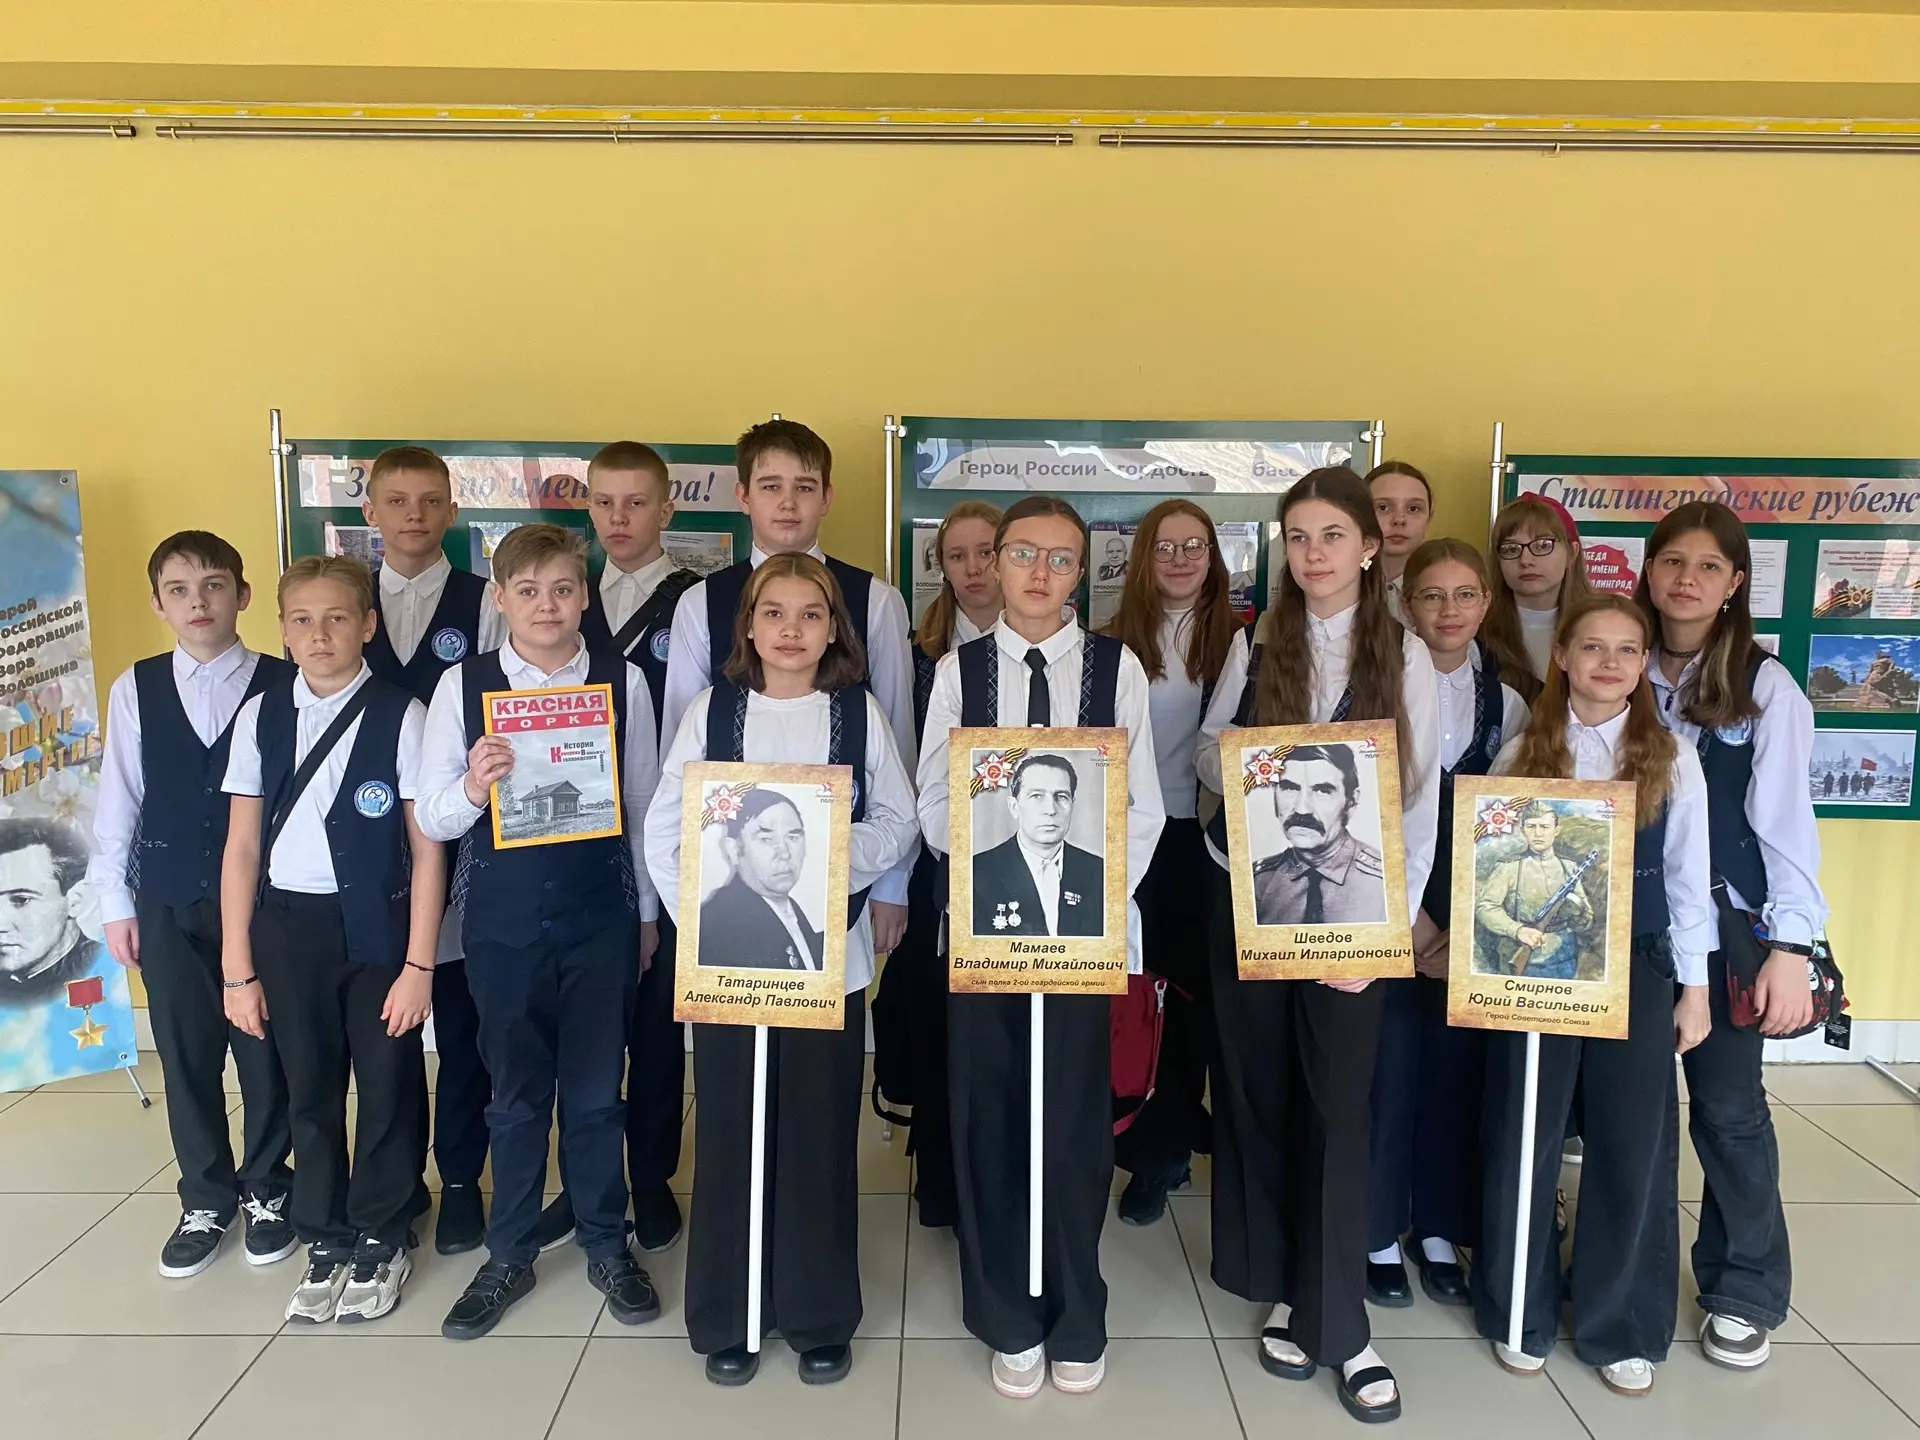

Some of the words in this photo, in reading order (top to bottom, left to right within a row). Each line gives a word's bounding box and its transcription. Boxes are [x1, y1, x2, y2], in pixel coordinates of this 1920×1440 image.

[959, 460, 1018, 478] Герои
[1025, 461, 1097, 476] России
[1591, 565, 1619, 574] ИМЕНИ
[1, 600, 83, 639] оссийской
[496, 694, 602, 715] КРАСНАЯ
[497, 713, 604, 730] ГОРКА
[564, 741, 594, 750] История
[1294, 932, 1353, 944] Шведов
[1009, 942, 1066, 953] Мамаев
[1240, 949, 1296, 961] Михаил
[1300, 948, 1411, 961] Илларионович
[953, 958, 1028, 972] Владимир
[1032, 958, 1124, 971] Михайлович
[717, 975, 805, 991] Татаринцев
[1504, 979, 1573, 995] Смирнов
[684, 991, 761, 1008] Александр
[765, 994, 836, 1009] Павлович
[1468, 992, 1512, 1007] Юрий
[1516, 997, 1609, 1013] Васильевич
[1485, 1011, 1510, 1020] Герой
[1511, 1013, 1561, 1024] Советского
[1563, 1017, 1590, 1026] Союза
